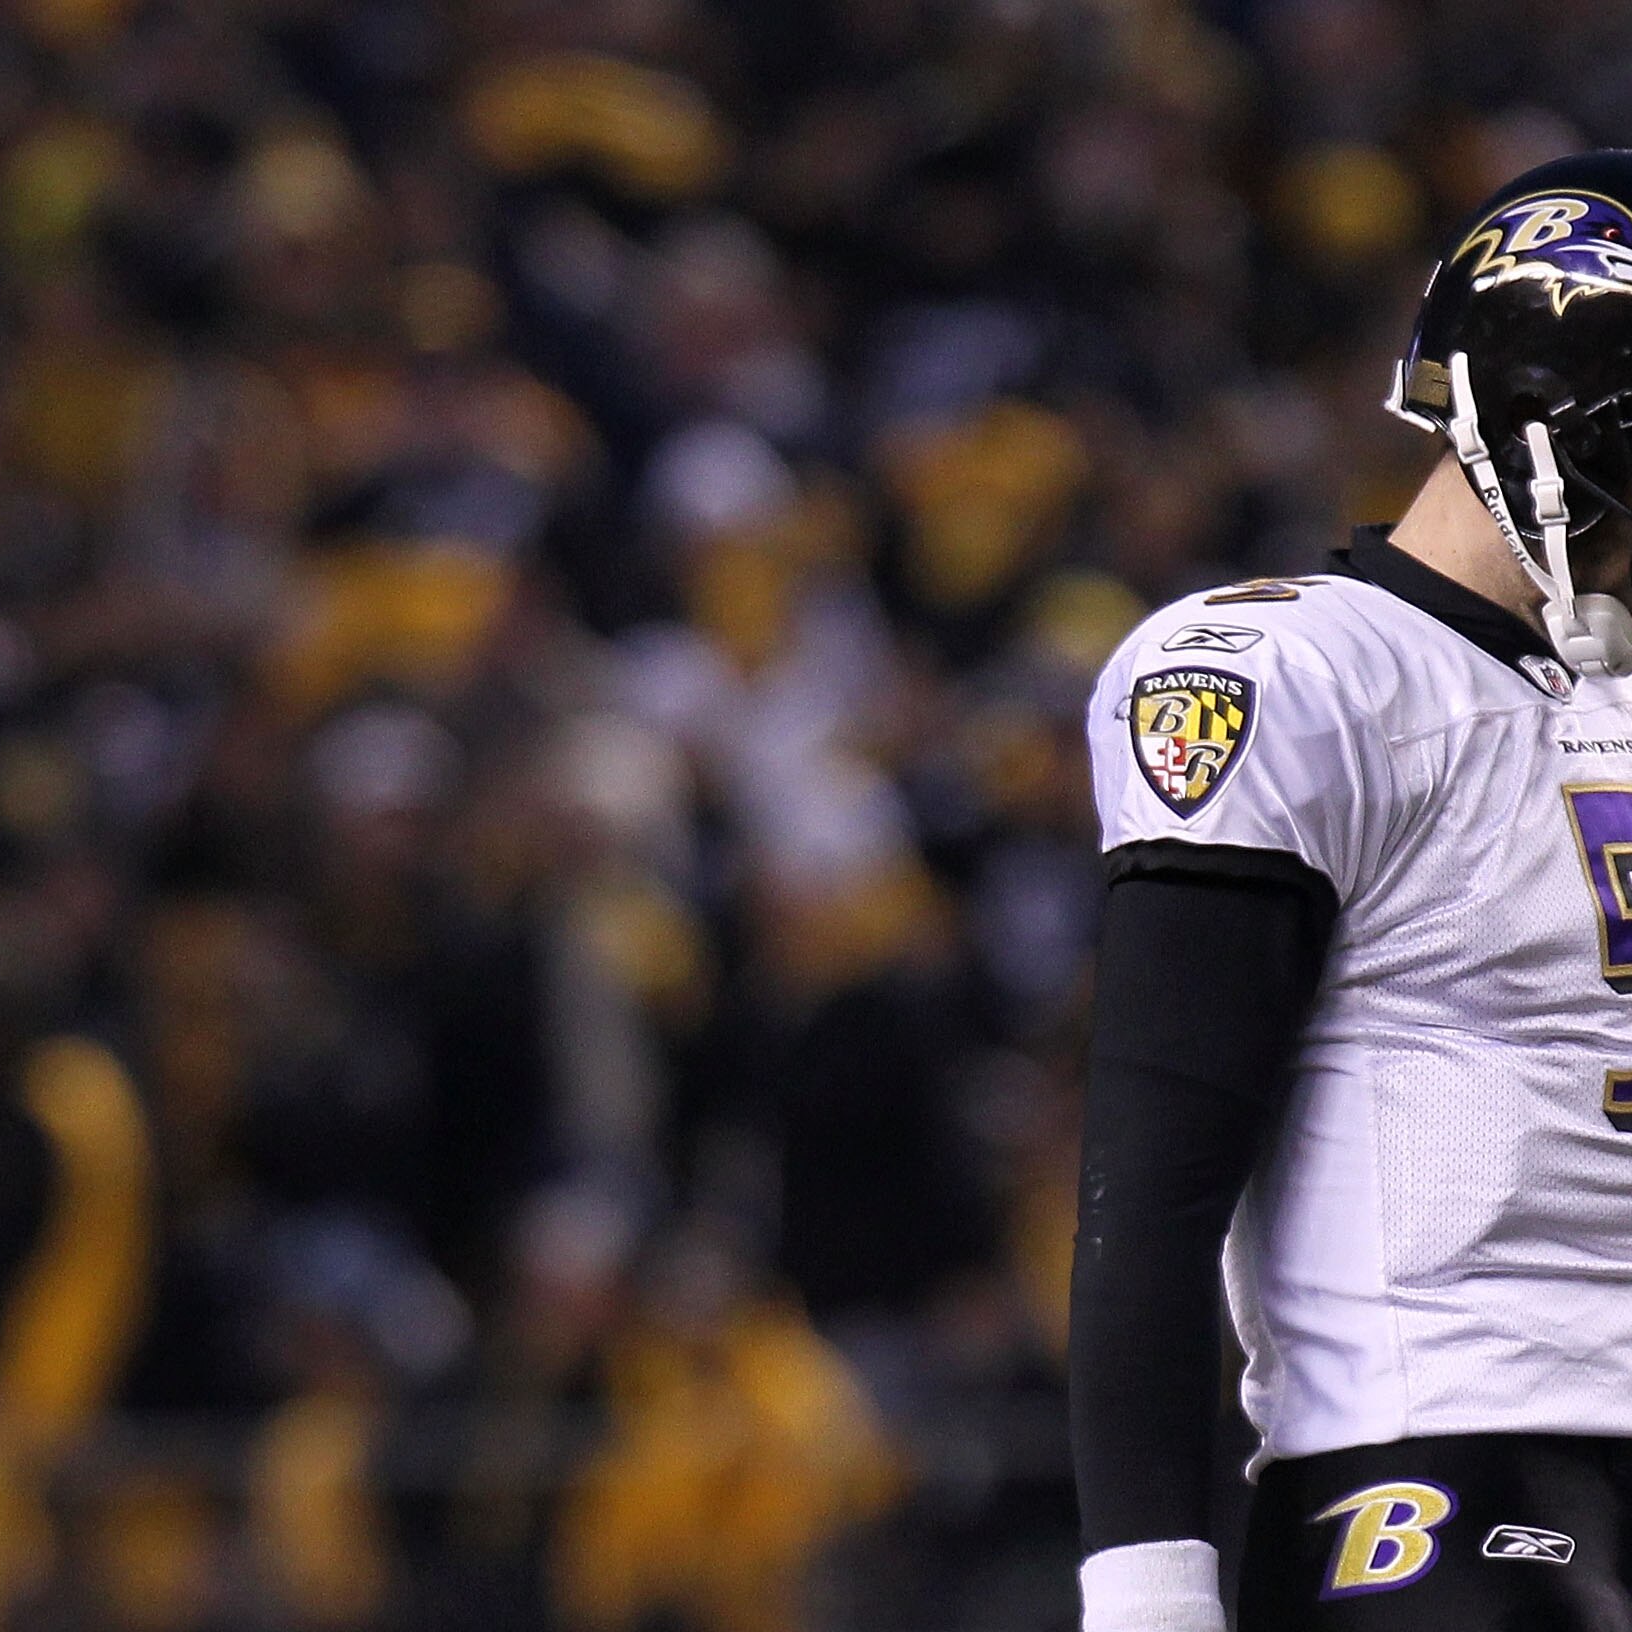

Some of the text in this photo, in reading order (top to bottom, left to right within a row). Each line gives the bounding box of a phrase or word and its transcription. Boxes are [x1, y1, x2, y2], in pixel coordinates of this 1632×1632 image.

[1501, 198, 1590, 253] B
[1143, 672, 1244, 697] RAVENS
[1148, 694, 1193, 736] B
[1312, 1480, 1455, 1596] B
